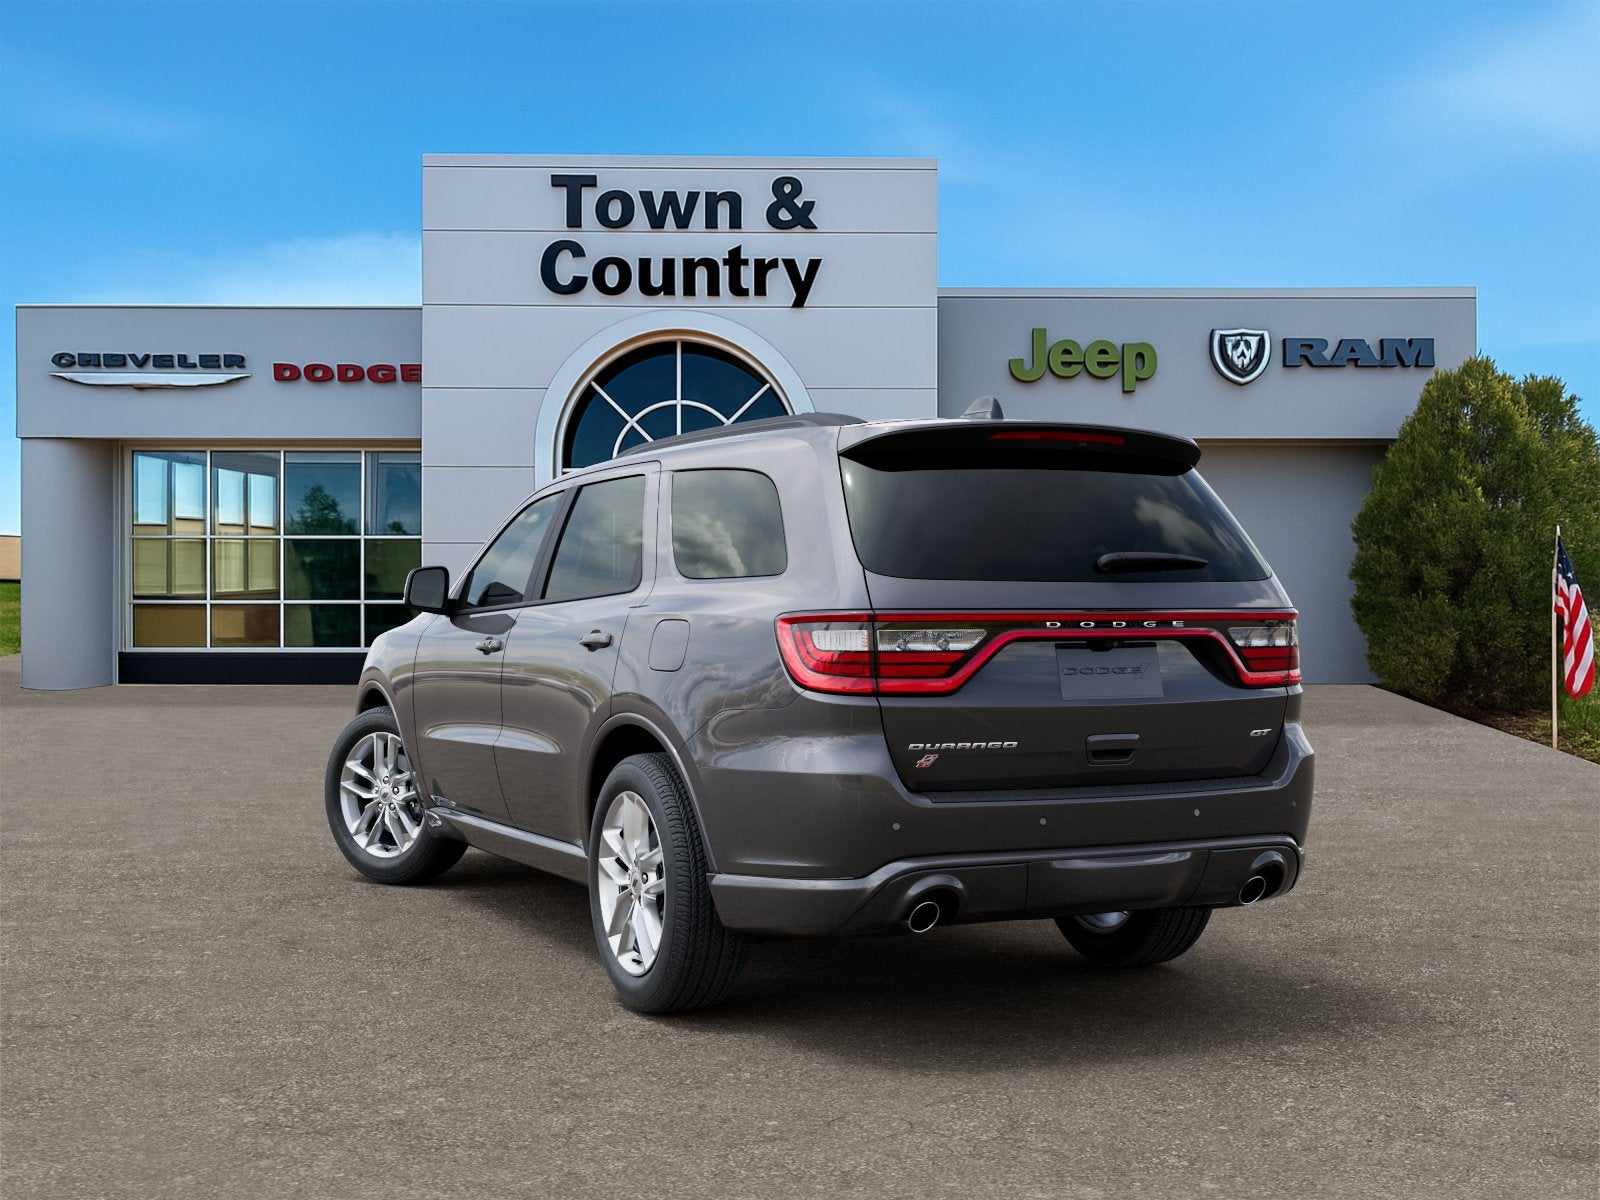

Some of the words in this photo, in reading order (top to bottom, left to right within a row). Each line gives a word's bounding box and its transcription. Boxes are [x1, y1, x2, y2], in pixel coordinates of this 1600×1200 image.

[550, 174, 742, 230] Town
[765, 175, 818, 231] &
[540, 239, 822, 308] Country
[1009, 328, 1157, 392] Jeep
[1282, 337, 1437, 368] RAM
[273, 362, 422, 383] DODGE
[1045, 620, 1186, 629] DODGE
[1063, 666, 1144, 676] DODGE
[1249, 728, 1272, 737] GT
[907, 741, 1019, 751] DURANGO
